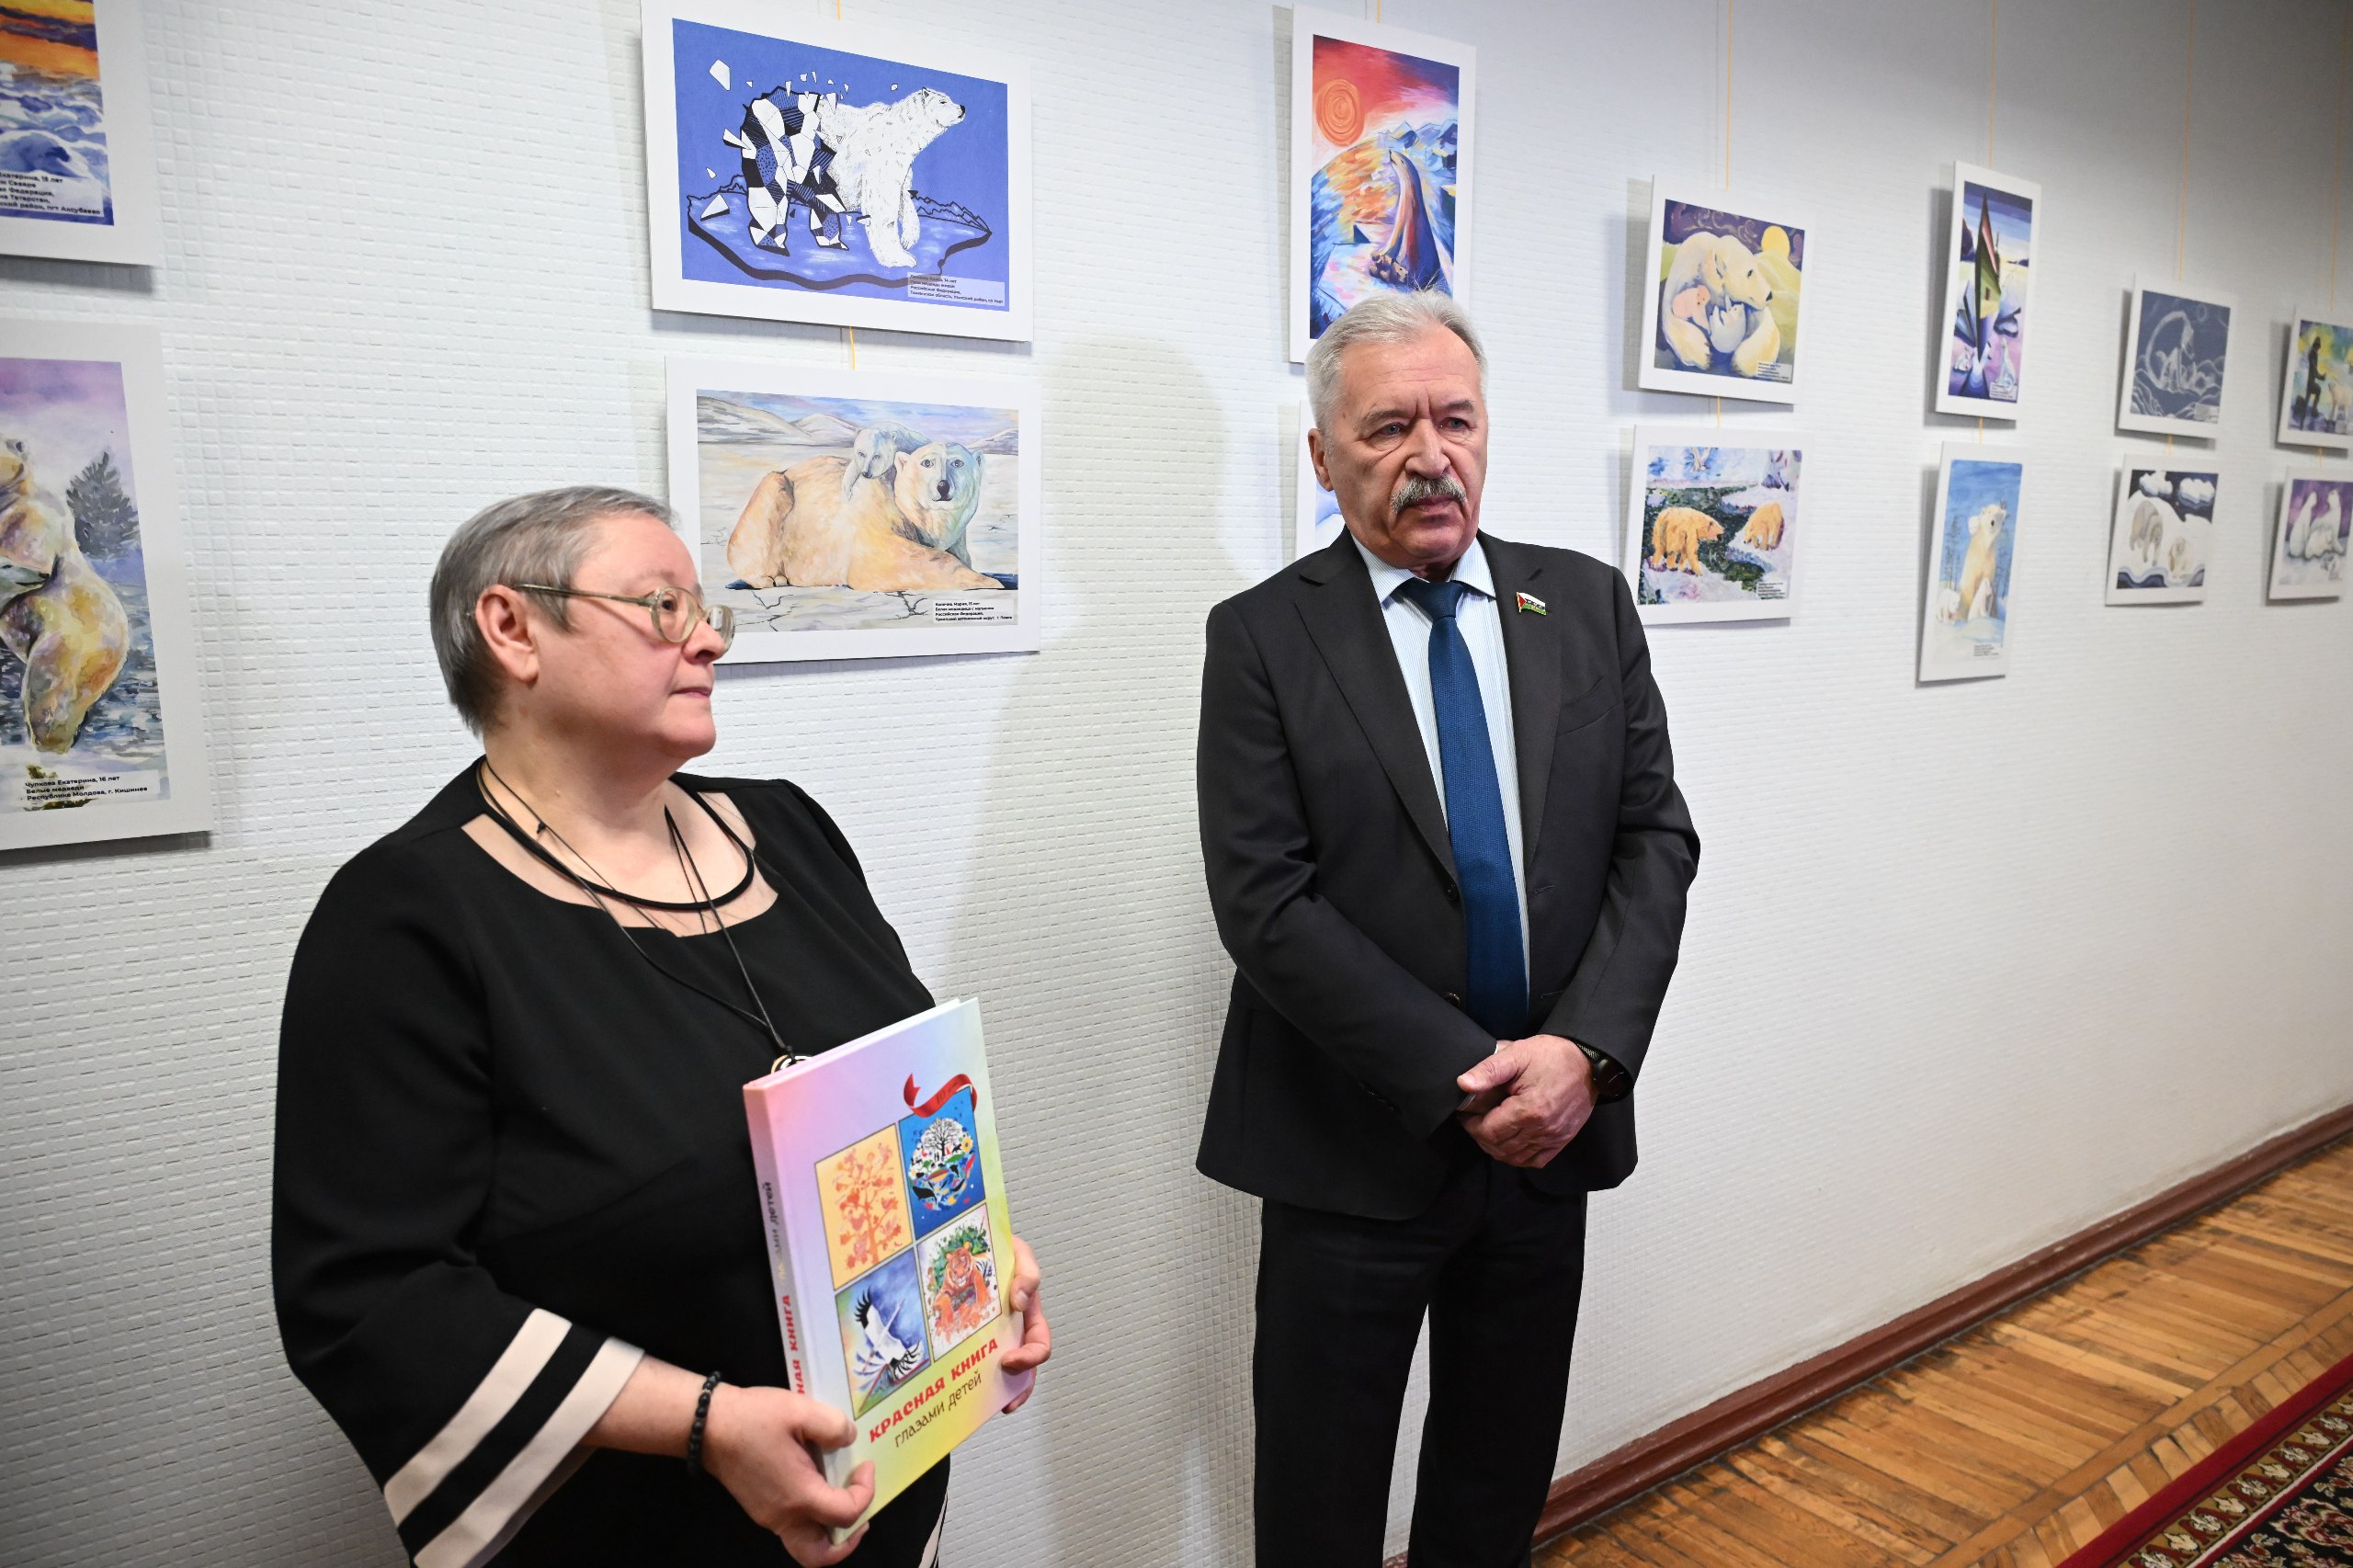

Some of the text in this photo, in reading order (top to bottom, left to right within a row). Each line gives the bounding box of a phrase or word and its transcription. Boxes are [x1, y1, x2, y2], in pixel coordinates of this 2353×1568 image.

[27, 792, 72, 801] Республика
[57, 778, 98, 786] Екатерина,
[782, 1294, 799, 1352] КНИГА
[869, 1338, 999, 1443] КРАСНАЯ КНИГА
[894, 1369, 982, 1448] глазами детей
